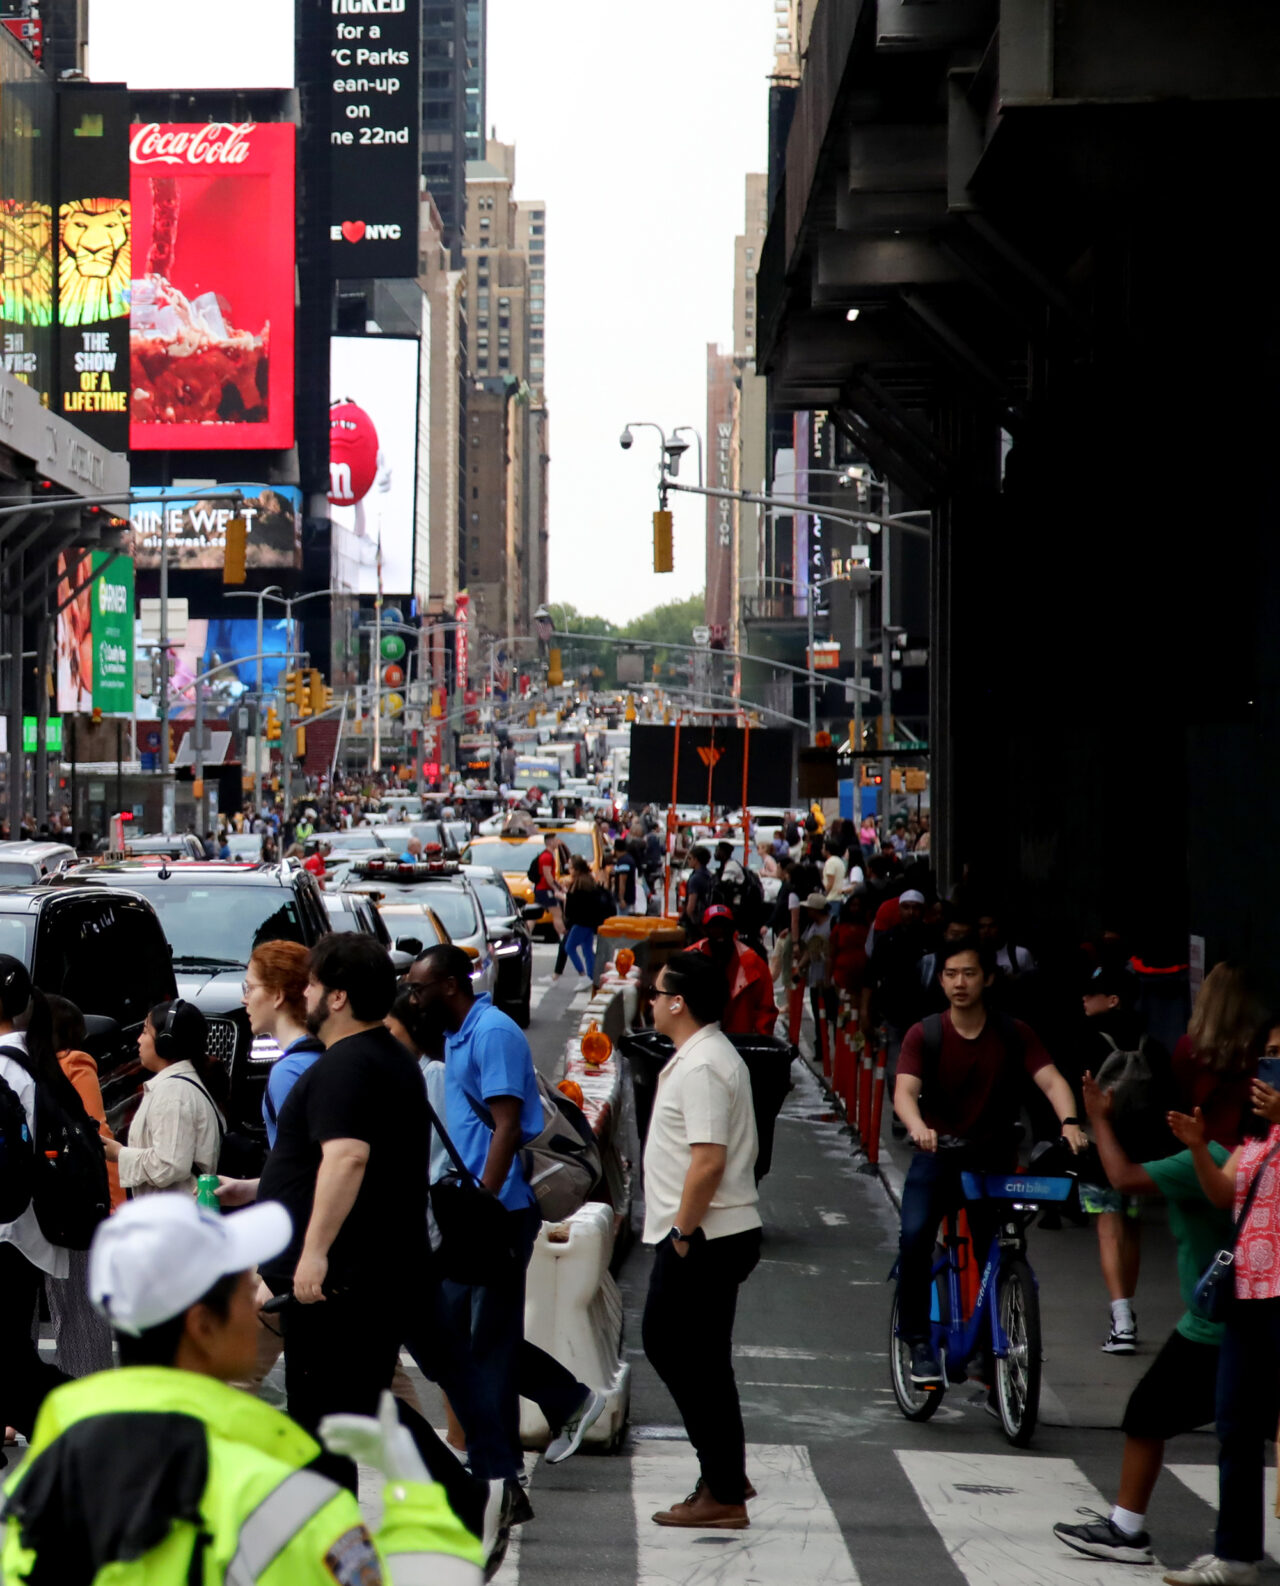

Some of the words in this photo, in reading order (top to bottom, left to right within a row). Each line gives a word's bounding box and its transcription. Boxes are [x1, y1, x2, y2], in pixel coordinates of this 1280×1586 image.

[336, 23, 364, 39] for
[369, 25, 381, 39] a
[356, 48, 409, 65] Parks
[346, 105, 370, 118] on
[129, 122, 257, 165] Coca-Cola
[359, 127, 409, 144] 22nd
[365, 224, 402, 240] NYC
[81, 332, 110, 352] THE
[74, 352, 117, 372] SHOW
[80, 372, 99, 392] OF
[100, 372, 112, 392] A
[64, 391, 127, 412] LIFETIME
[716, 423, 733, 546] WELLIGTON
[188, 508, 258, 534] WET
